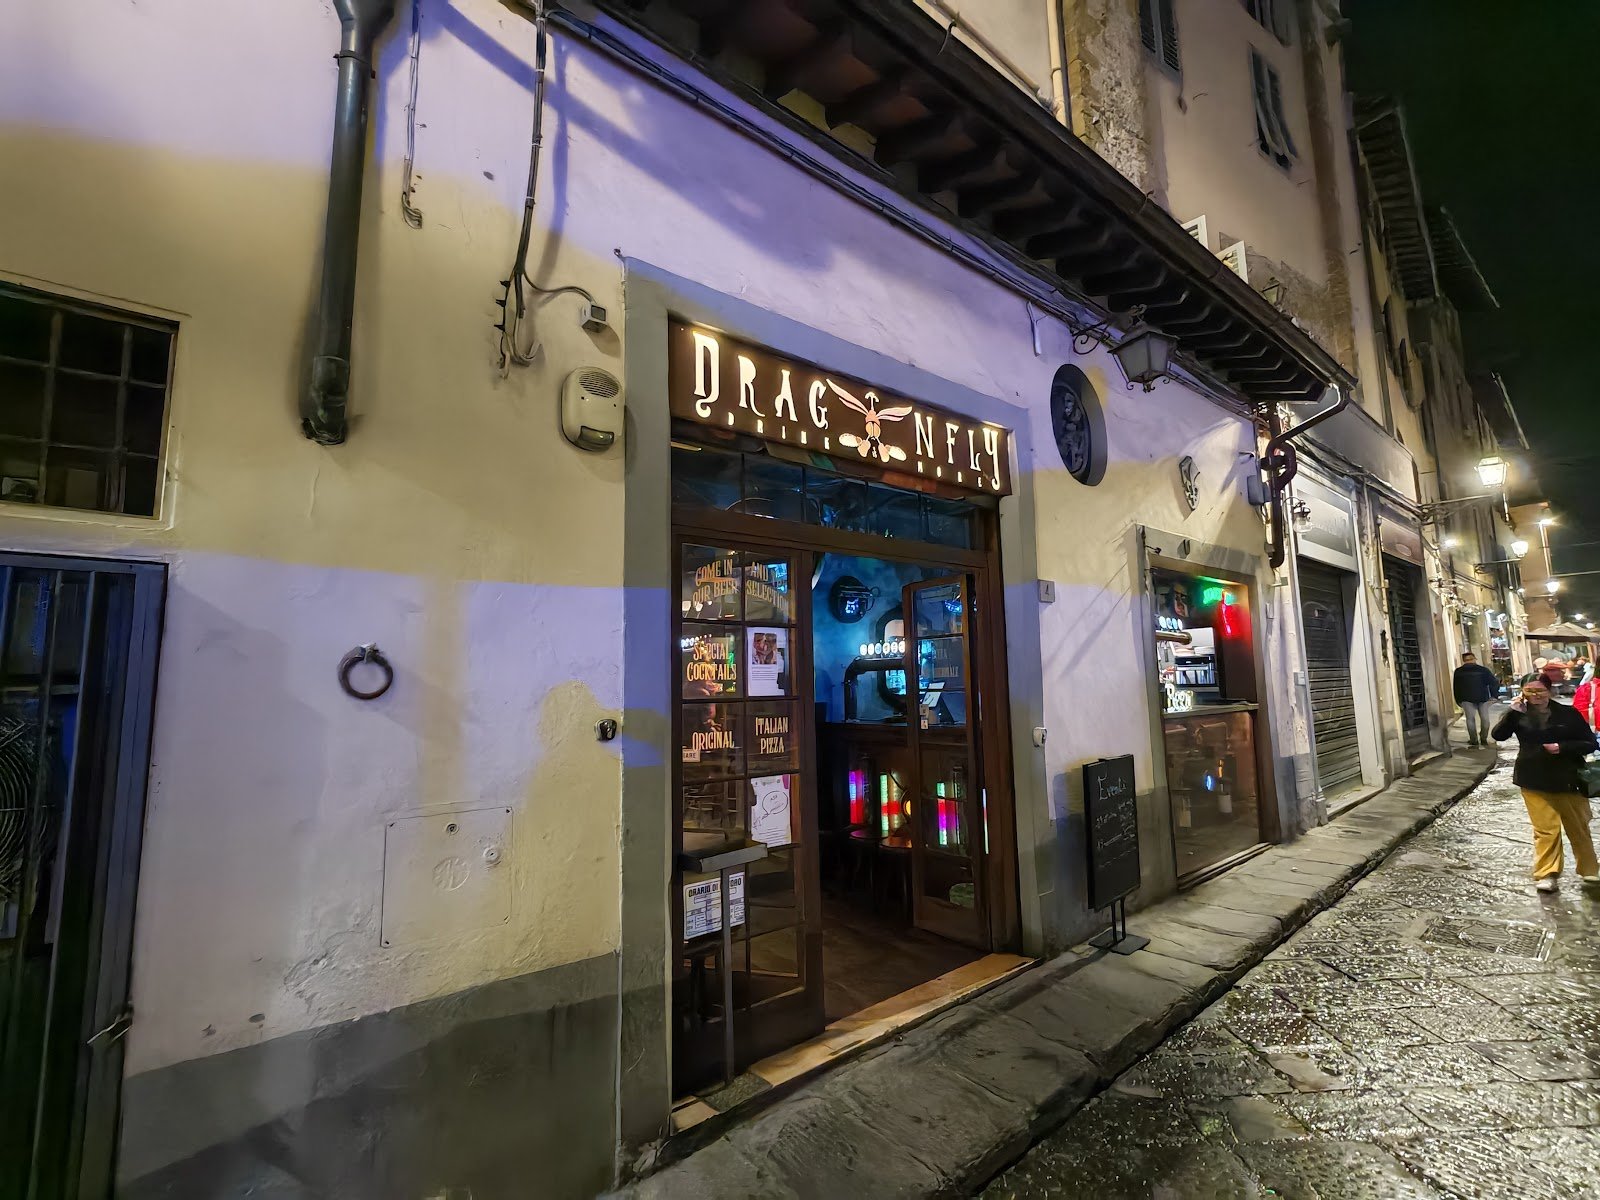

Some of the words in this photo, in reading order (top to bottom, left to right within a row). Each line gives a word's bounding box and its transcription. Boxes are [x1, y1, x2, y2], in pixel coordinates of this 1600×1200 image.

[727, 412, 830, 450] DRINK
[917, 461, 983, 488] MORE
[695, 560, 721, 587] COME
[723, 558, 733, 576] IN
[750, 561, 769, 582] AND
[692, 585, 711, 609] OUR
[713, 579, 738, 598] BEER
[746, 579, 789, 614] SELECTION
[693, 642, 731, 661] SPECIAL
[686, 662, 737, 682] COCKTAILS
[755, 716, 789, 736] ITALIAN
[692, 730, 735, 752] ORIGINAL
[760, 736, 785, 755] PIZZA
[688, 884, 711, 898] ORARIO
